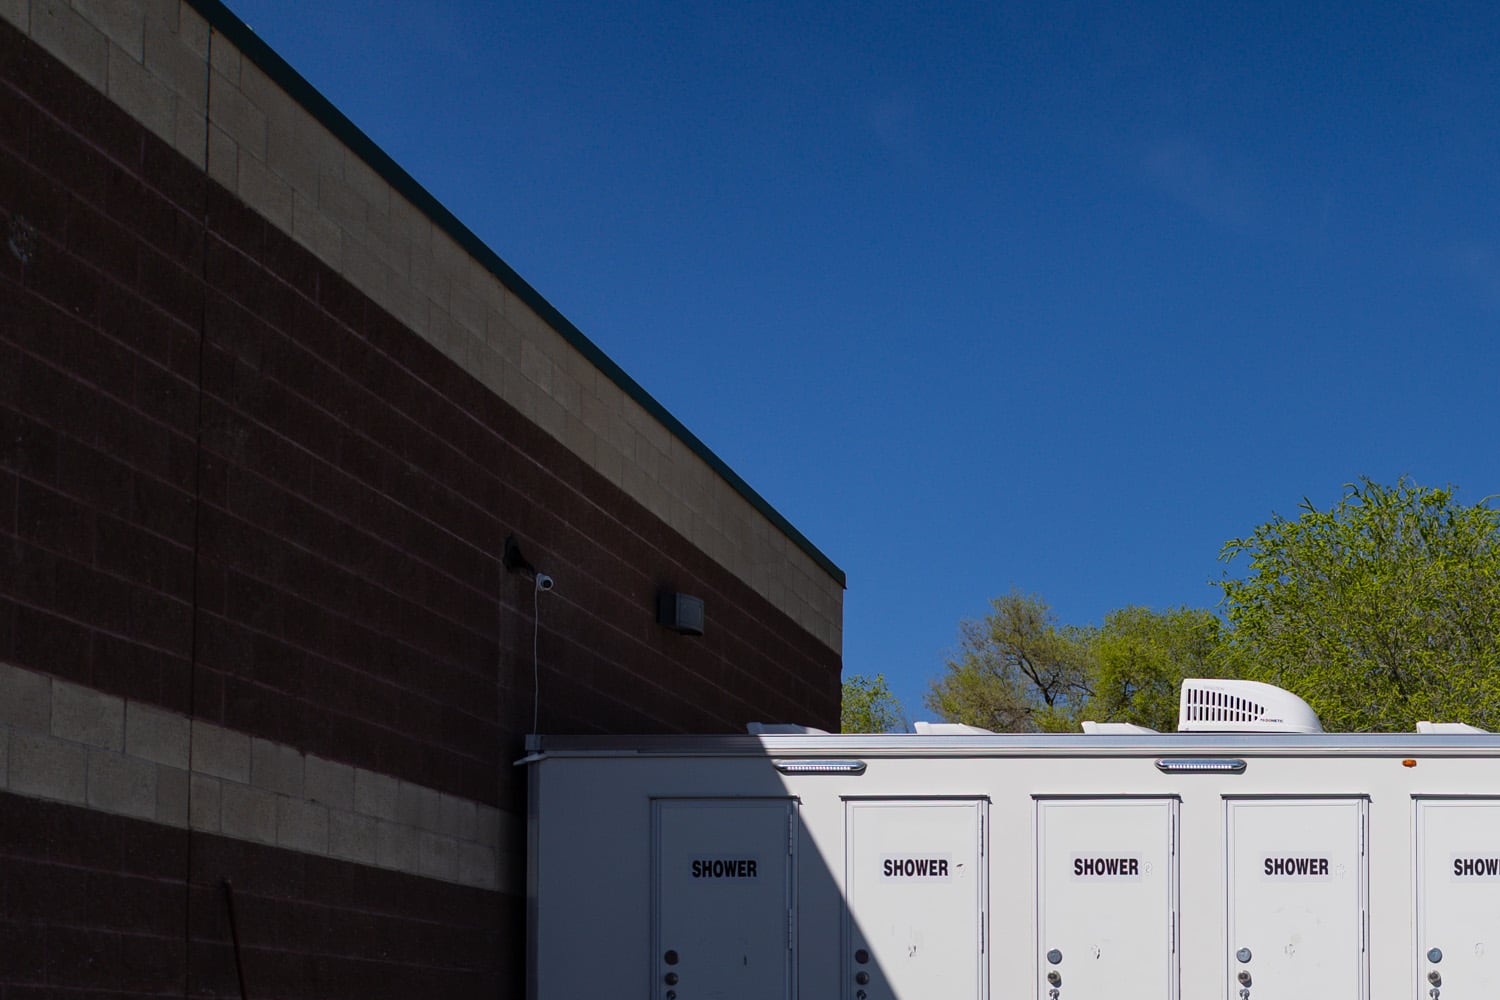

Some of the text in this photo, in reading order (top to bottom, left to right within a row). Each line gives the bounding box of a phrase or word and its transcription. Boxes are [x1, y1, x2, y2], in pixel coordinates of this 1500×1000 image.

[691, 860, 757, 878] SHOWER
[883, 859, 949, 877] SHOWER
[1073, 859, 1139, 876] SHOWER
[1264, 857, 1329, 876] SHOWER
